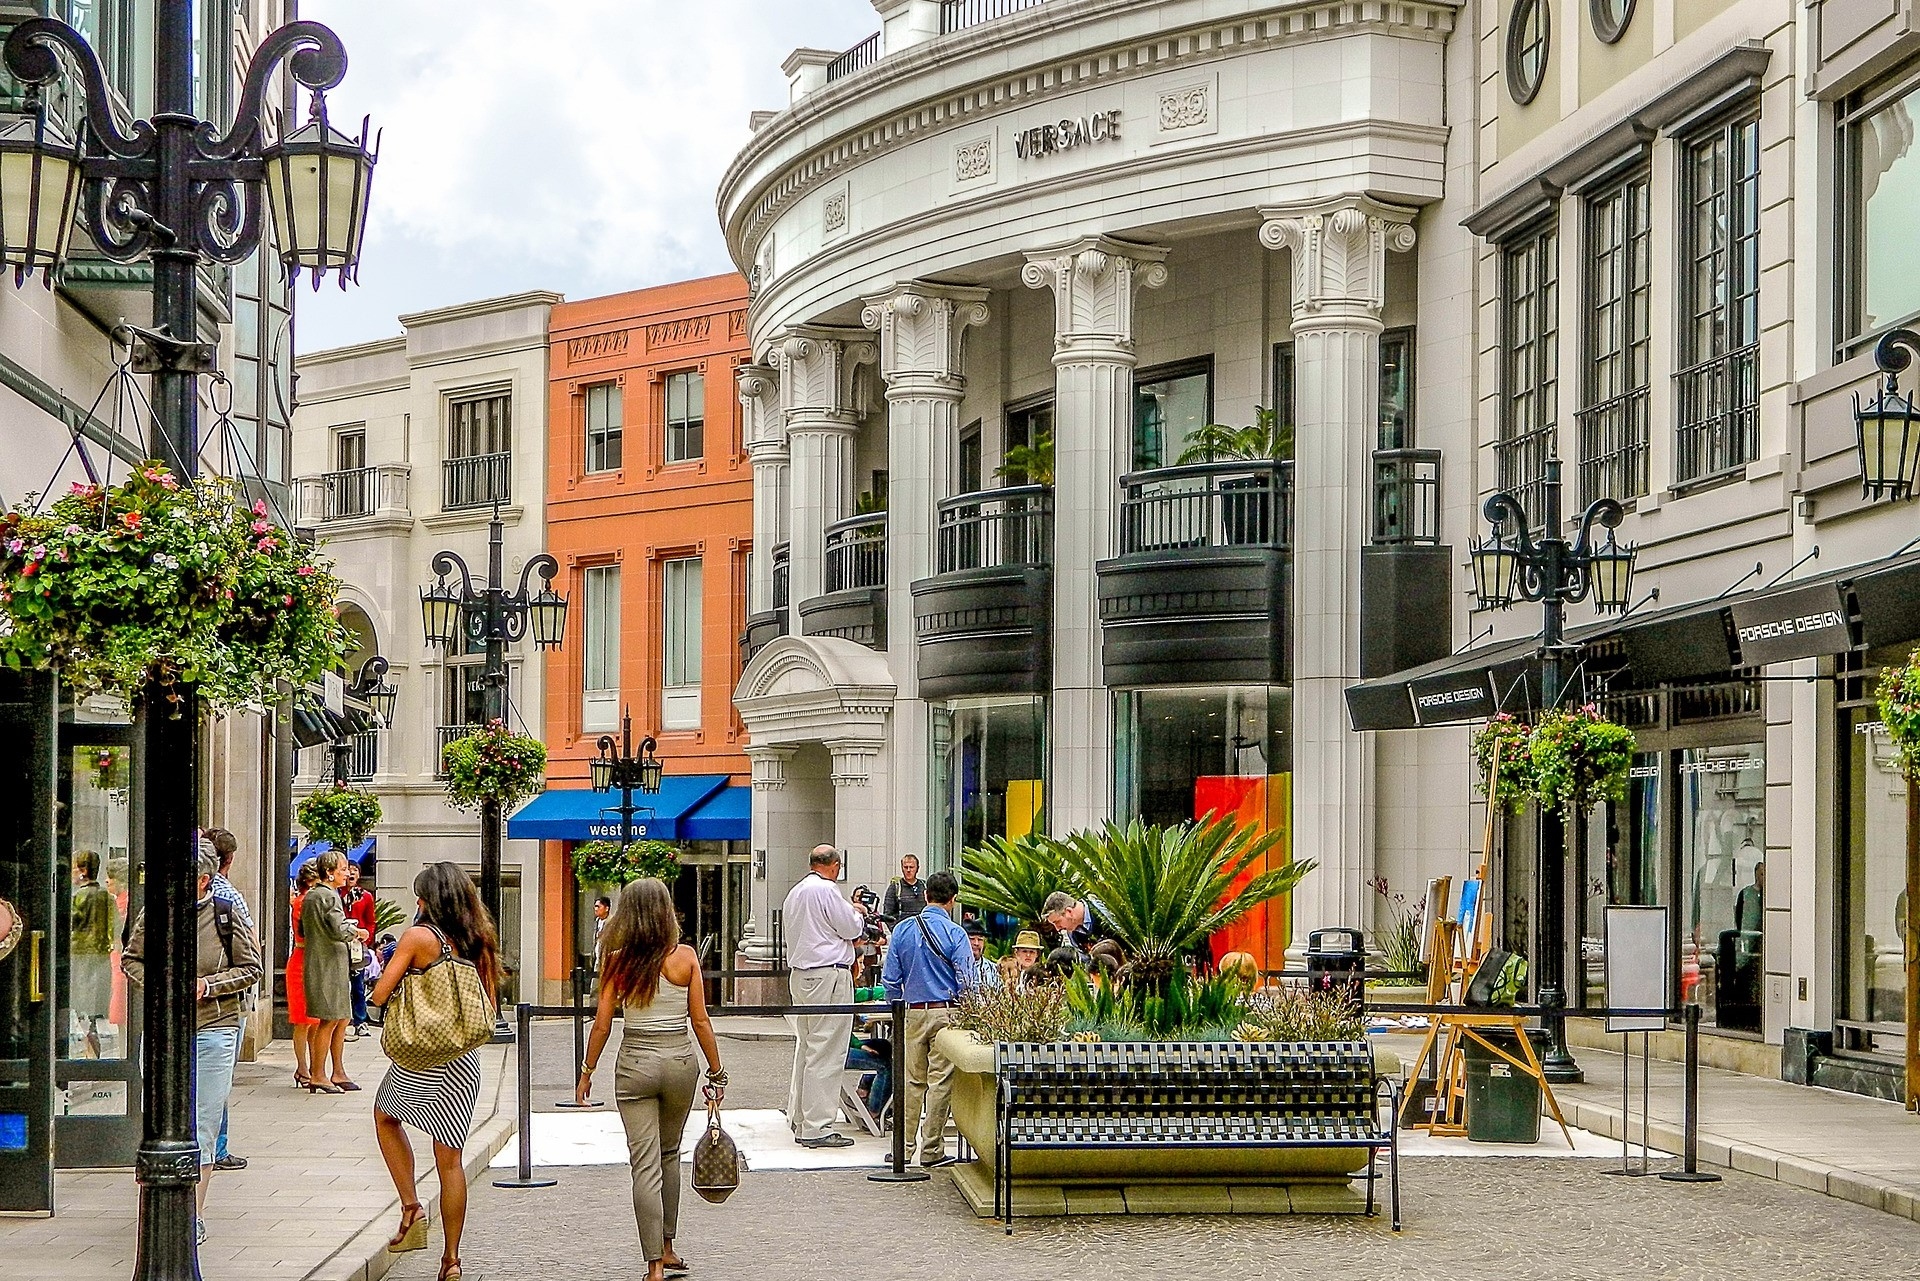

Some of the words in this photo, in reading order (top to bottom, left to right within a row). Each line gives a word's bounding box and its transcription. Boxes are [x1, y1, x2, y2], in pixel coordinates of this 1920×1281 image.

[1013, 109, 1122, 160] VERSACE
[1738, 619, 1795, 642] PORSCHE
[1795, 609, 1843, 633] DESIGN
[1418, 691, 1453, 708] PORSCHE
[1453, 687, 1484, 702] DESIGN
[1679, 761, 1726, 774] PORSCHE
